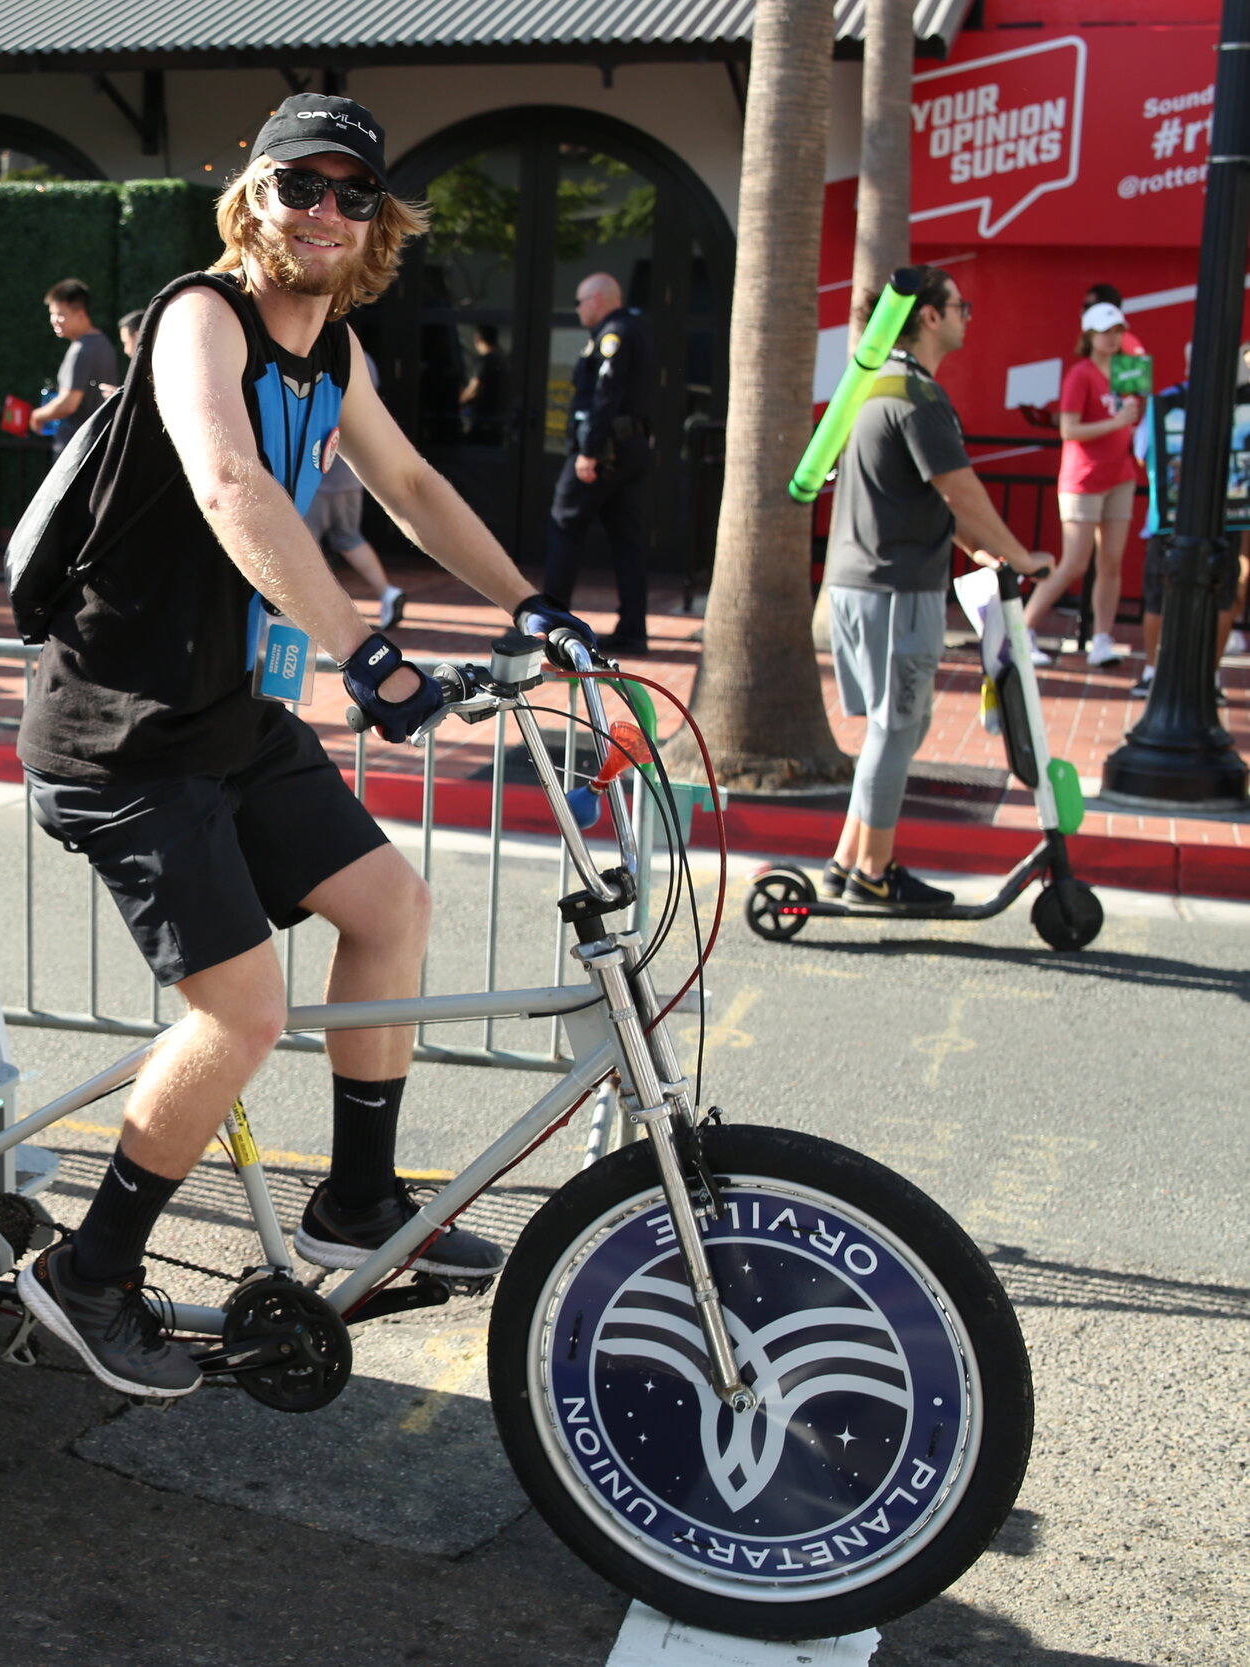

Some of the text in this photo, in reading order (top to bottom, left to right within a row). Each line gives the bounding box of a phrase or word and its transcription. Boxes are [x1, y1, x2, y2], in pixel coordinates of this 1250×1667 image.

[910, 84, 999, 132] YOUR
[1142, 83, 1215, 119] Sound
[296, 110, 378, 143] ORVILLE
[929, 97, 1067, 159] OPINION
[950, 131, 1062, 184] SUCKS
[282, 644, 300, 680] eaze
[368, 645, 390, 666] TKO
[563, 1397, 937, 1570] PLANETARY UNION
